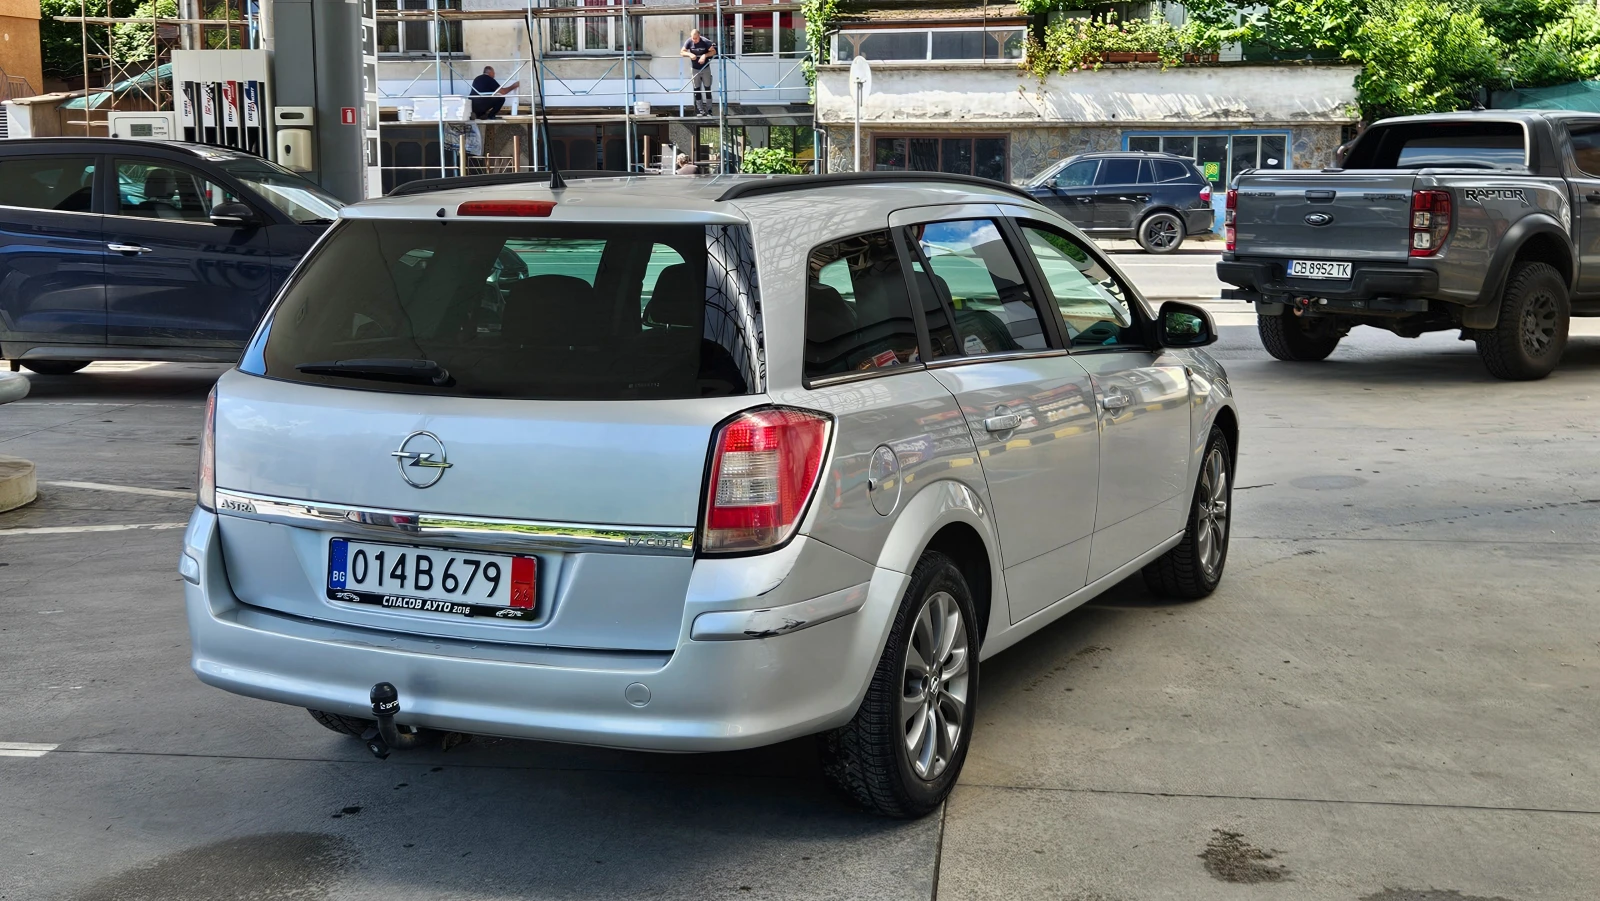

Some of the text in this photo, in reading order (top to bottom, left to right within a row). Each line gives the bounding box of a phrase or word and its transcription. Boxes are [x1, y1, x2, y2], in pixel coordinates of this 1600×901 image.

[1464, 188, 1529, 205] RAPTOR
[1309, 262, 1334, 276] 8952
[221, 499, 257, 514] ASTRA
[332, 570, 346, 582] BG
[382, 595, 471, 615] СПАСОВ АУТО 2016
